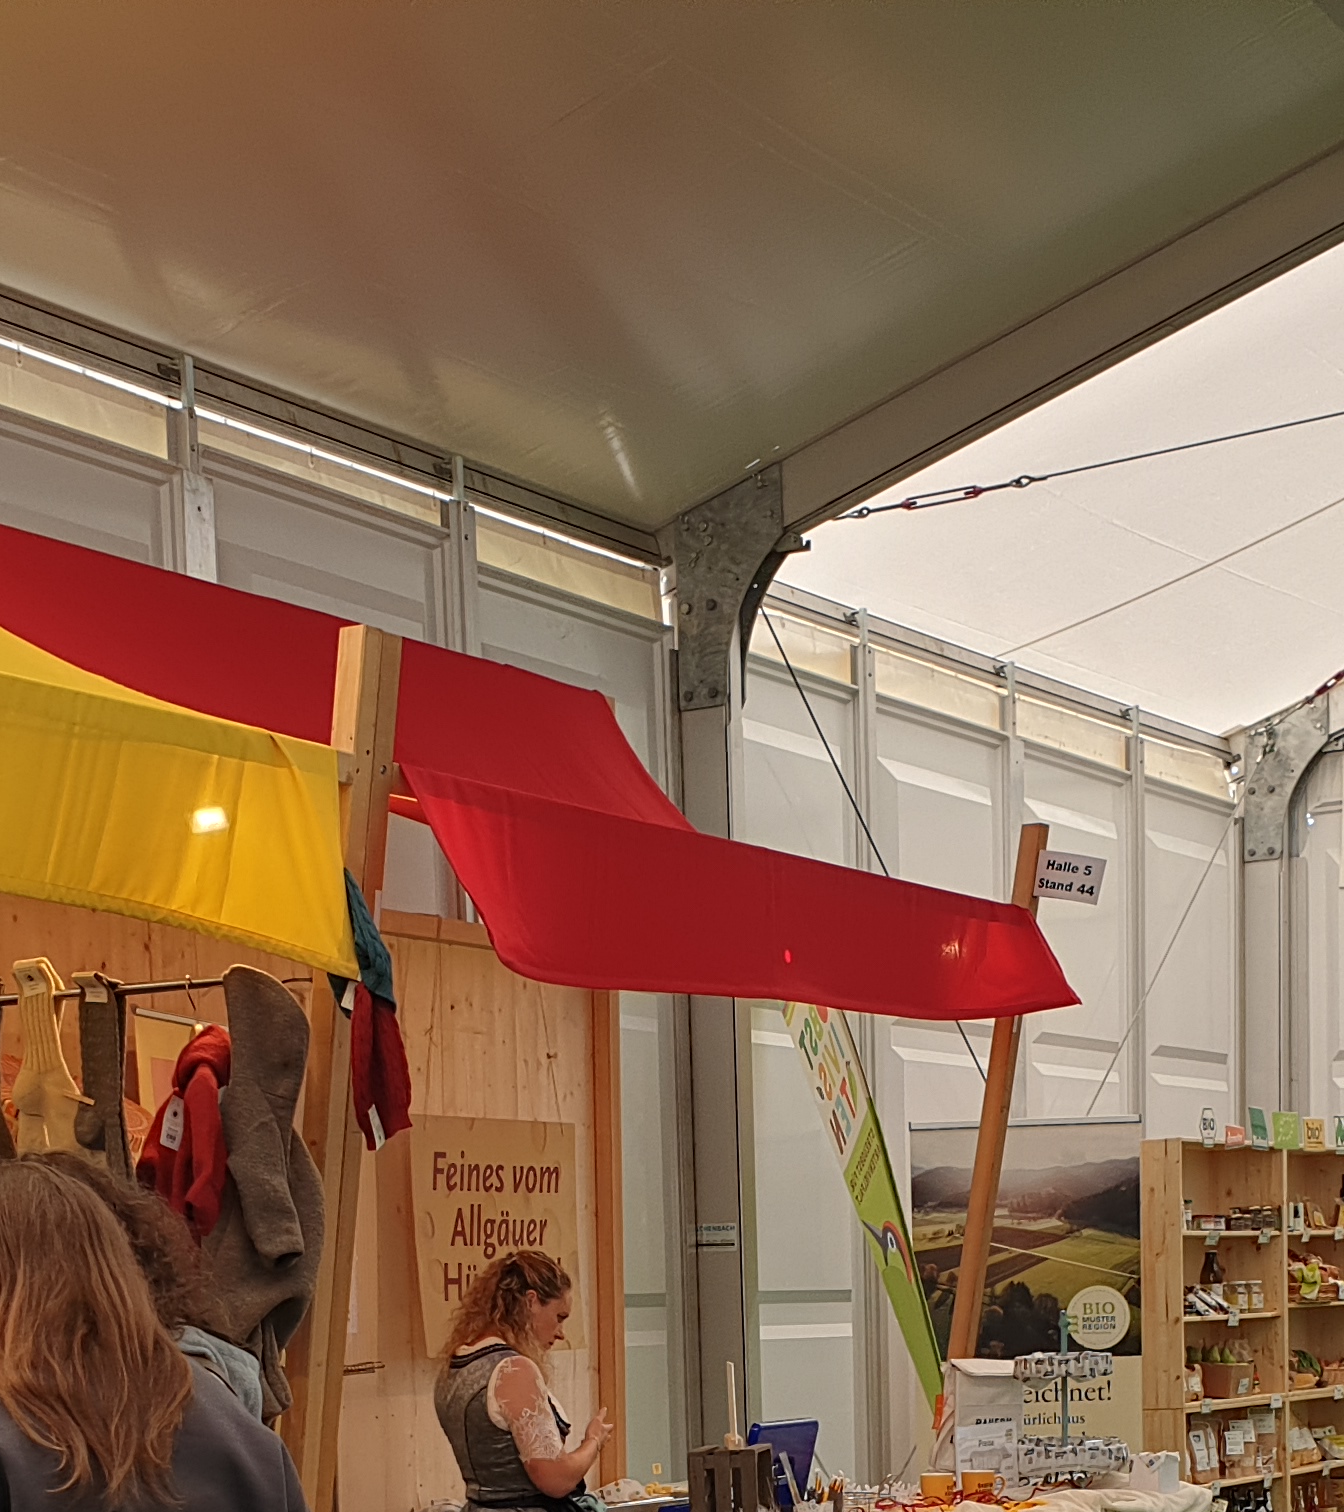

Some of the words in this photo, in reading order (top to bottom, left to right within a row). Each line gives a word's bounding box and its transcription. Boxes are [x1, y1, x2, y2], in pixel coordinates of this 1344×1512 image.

[1046, 859, 1079, 874] Halle
[1083, 865, 1092, 876] 5
[1038, 877, 1074, 892] Stand
[1076, 884, 1095, 896] 44
[433, 1150, 505, 1193] Feines
[512, 1165, 560, 1194] vom
[450, 1203, 548, 1260] Allgäuer
[1082, 1301, 1116, 1315] BIO
[1082, 1315, 1116, 1324] MUSTER
[1082, 1323, 1116, 1331] REGION
